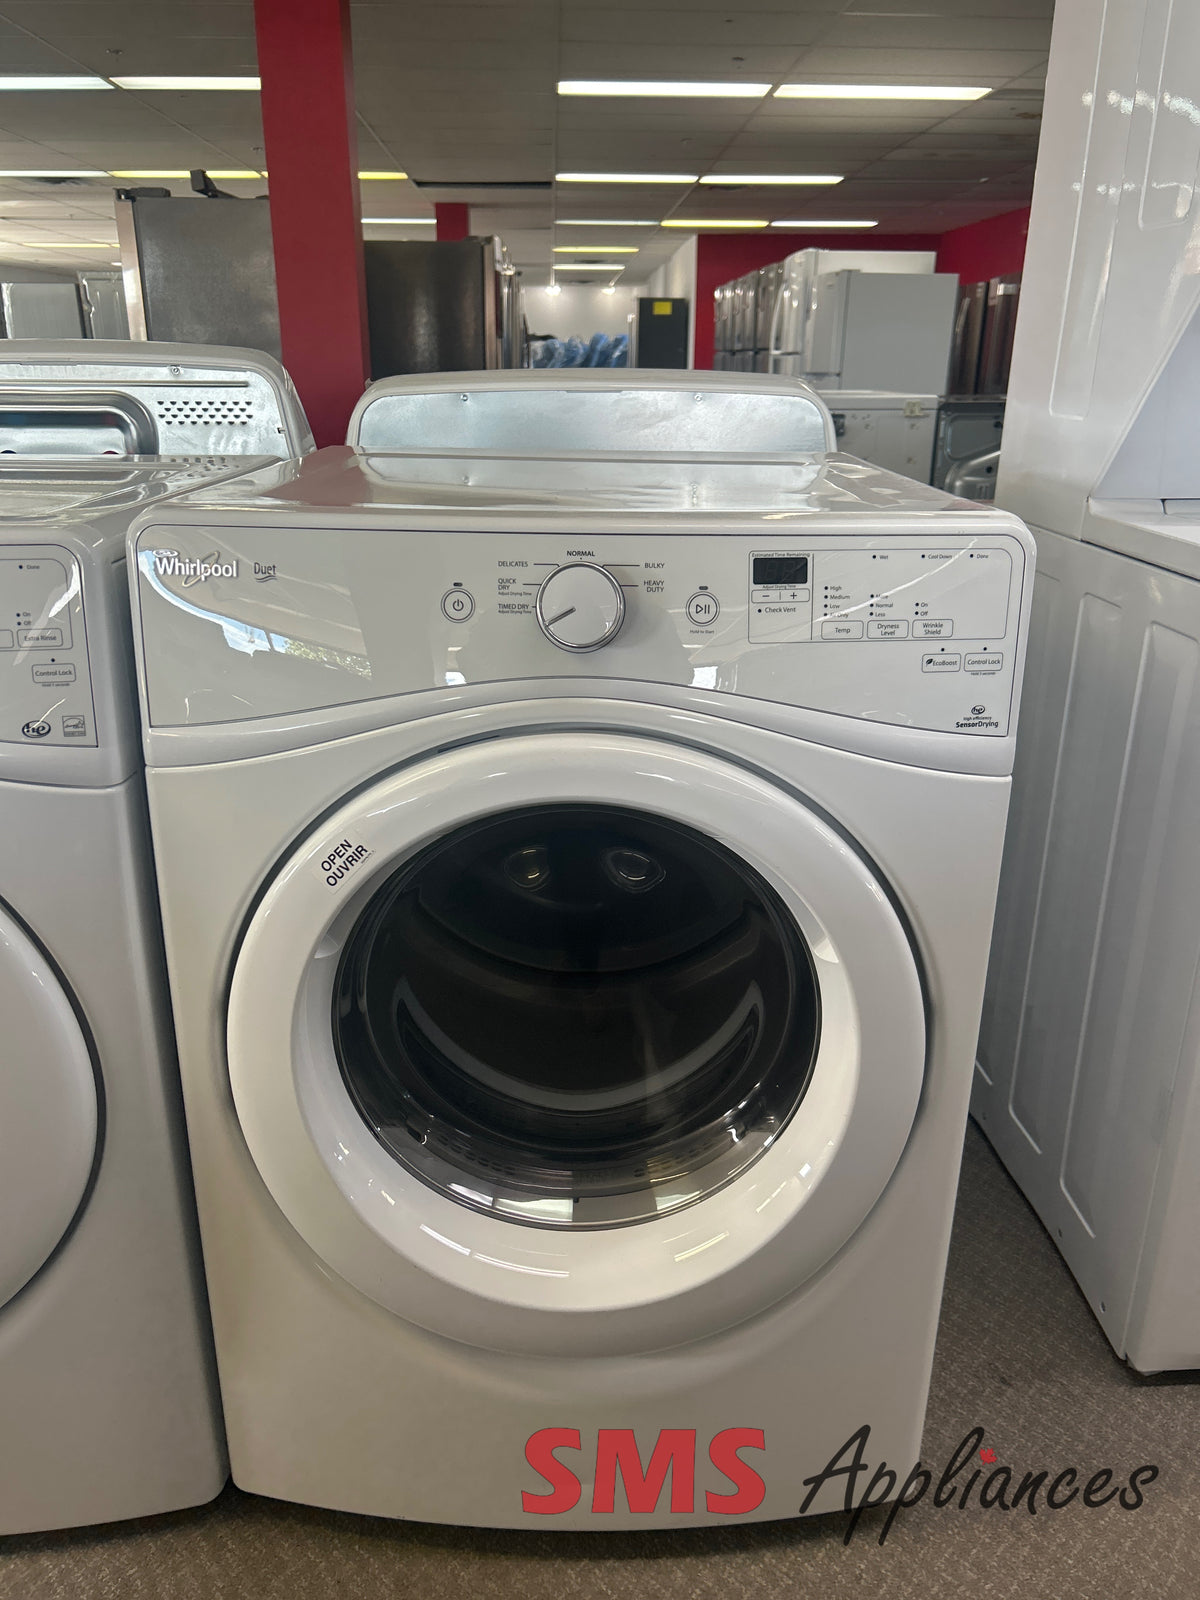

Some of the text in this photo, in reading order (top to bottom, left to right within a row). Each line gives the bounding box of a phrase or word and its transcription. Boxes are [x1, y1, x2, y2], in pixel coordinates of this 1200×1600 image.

[155, 557, 238, 582] Whirlpool
[253, 562, 277, 575] Duet
[877, 623, 900, 631] Dryness
[956, 721, 999, 729] SensorDrying
[321, 838, 353, 872] OPEN
[326, 844, 368, 887] OUVRIR
